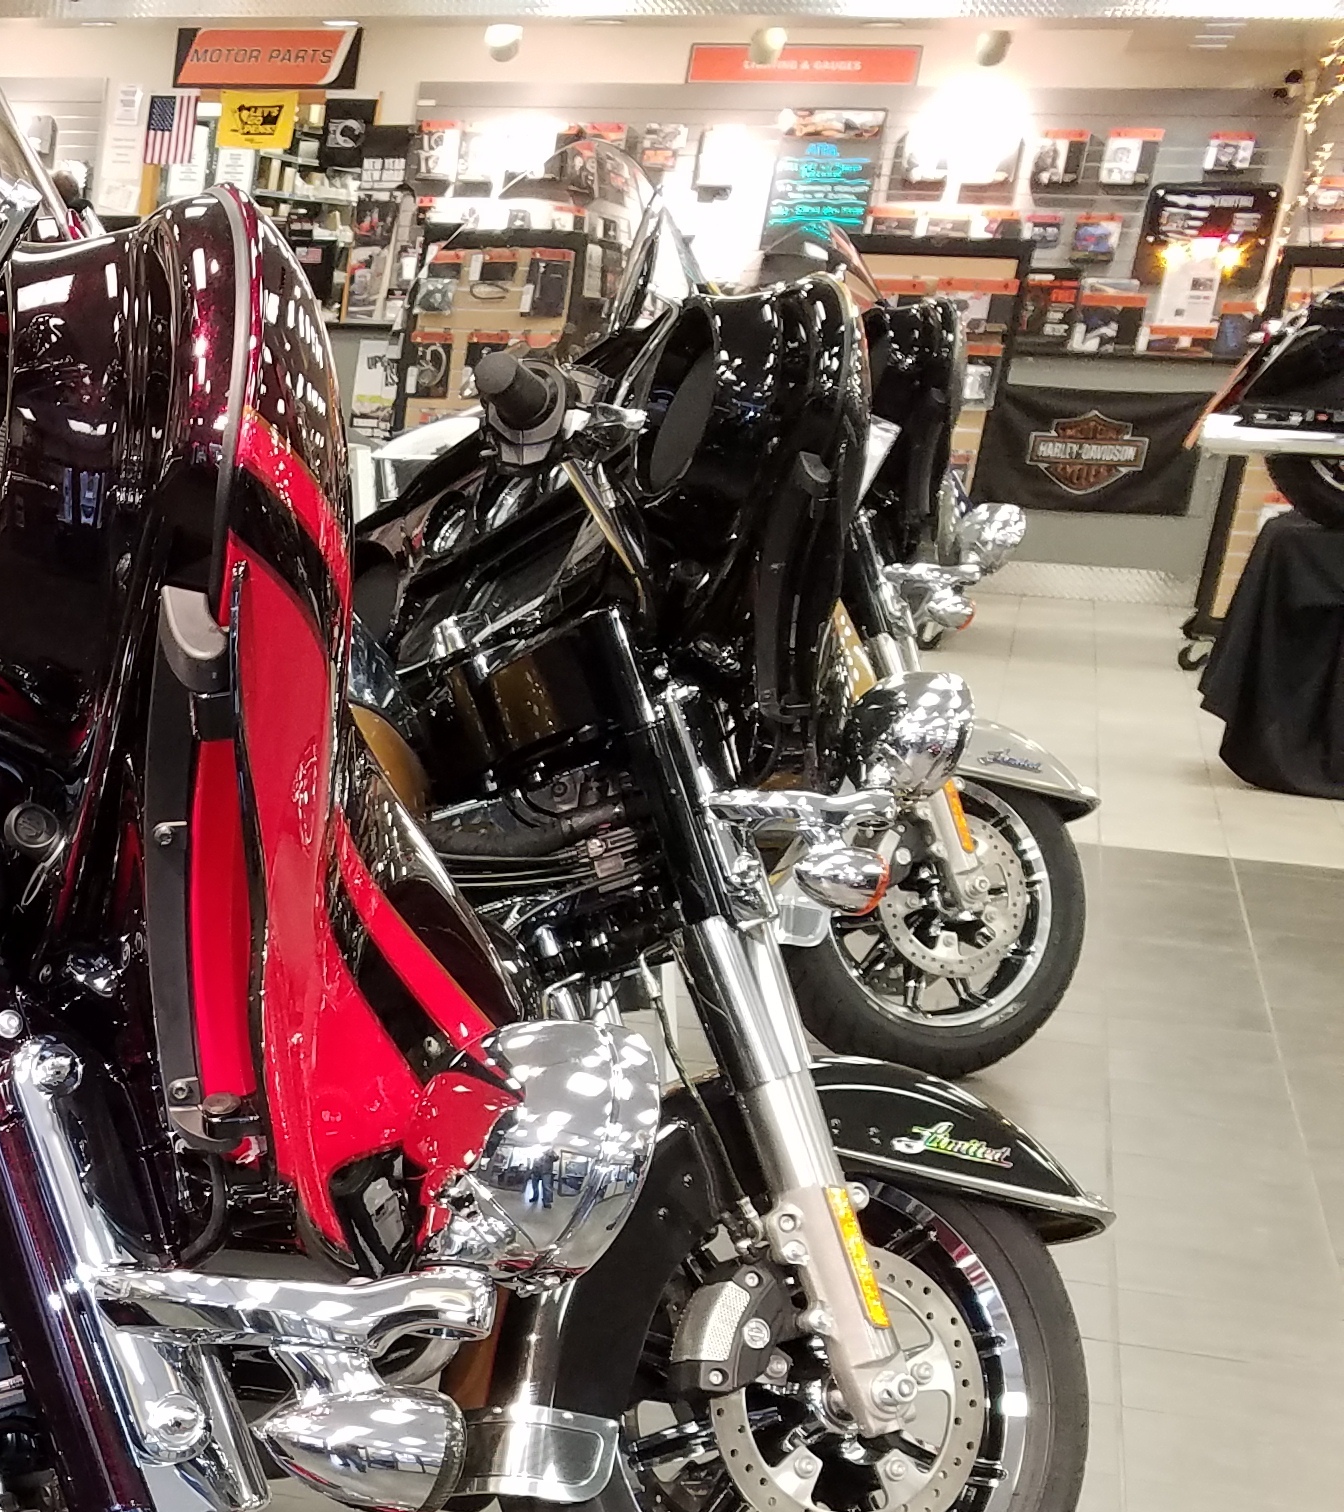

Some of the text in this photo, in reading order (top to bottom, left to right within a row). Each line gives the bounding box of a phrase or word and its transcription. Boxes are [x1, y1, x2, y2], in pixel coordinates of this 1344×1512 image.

[190, 48, 334, 64] MOTOR PARTS
[1037, 441, 1137, 462] HARLEY-DAVIDSON
[890, 1121, 1014, 1168] Limited
